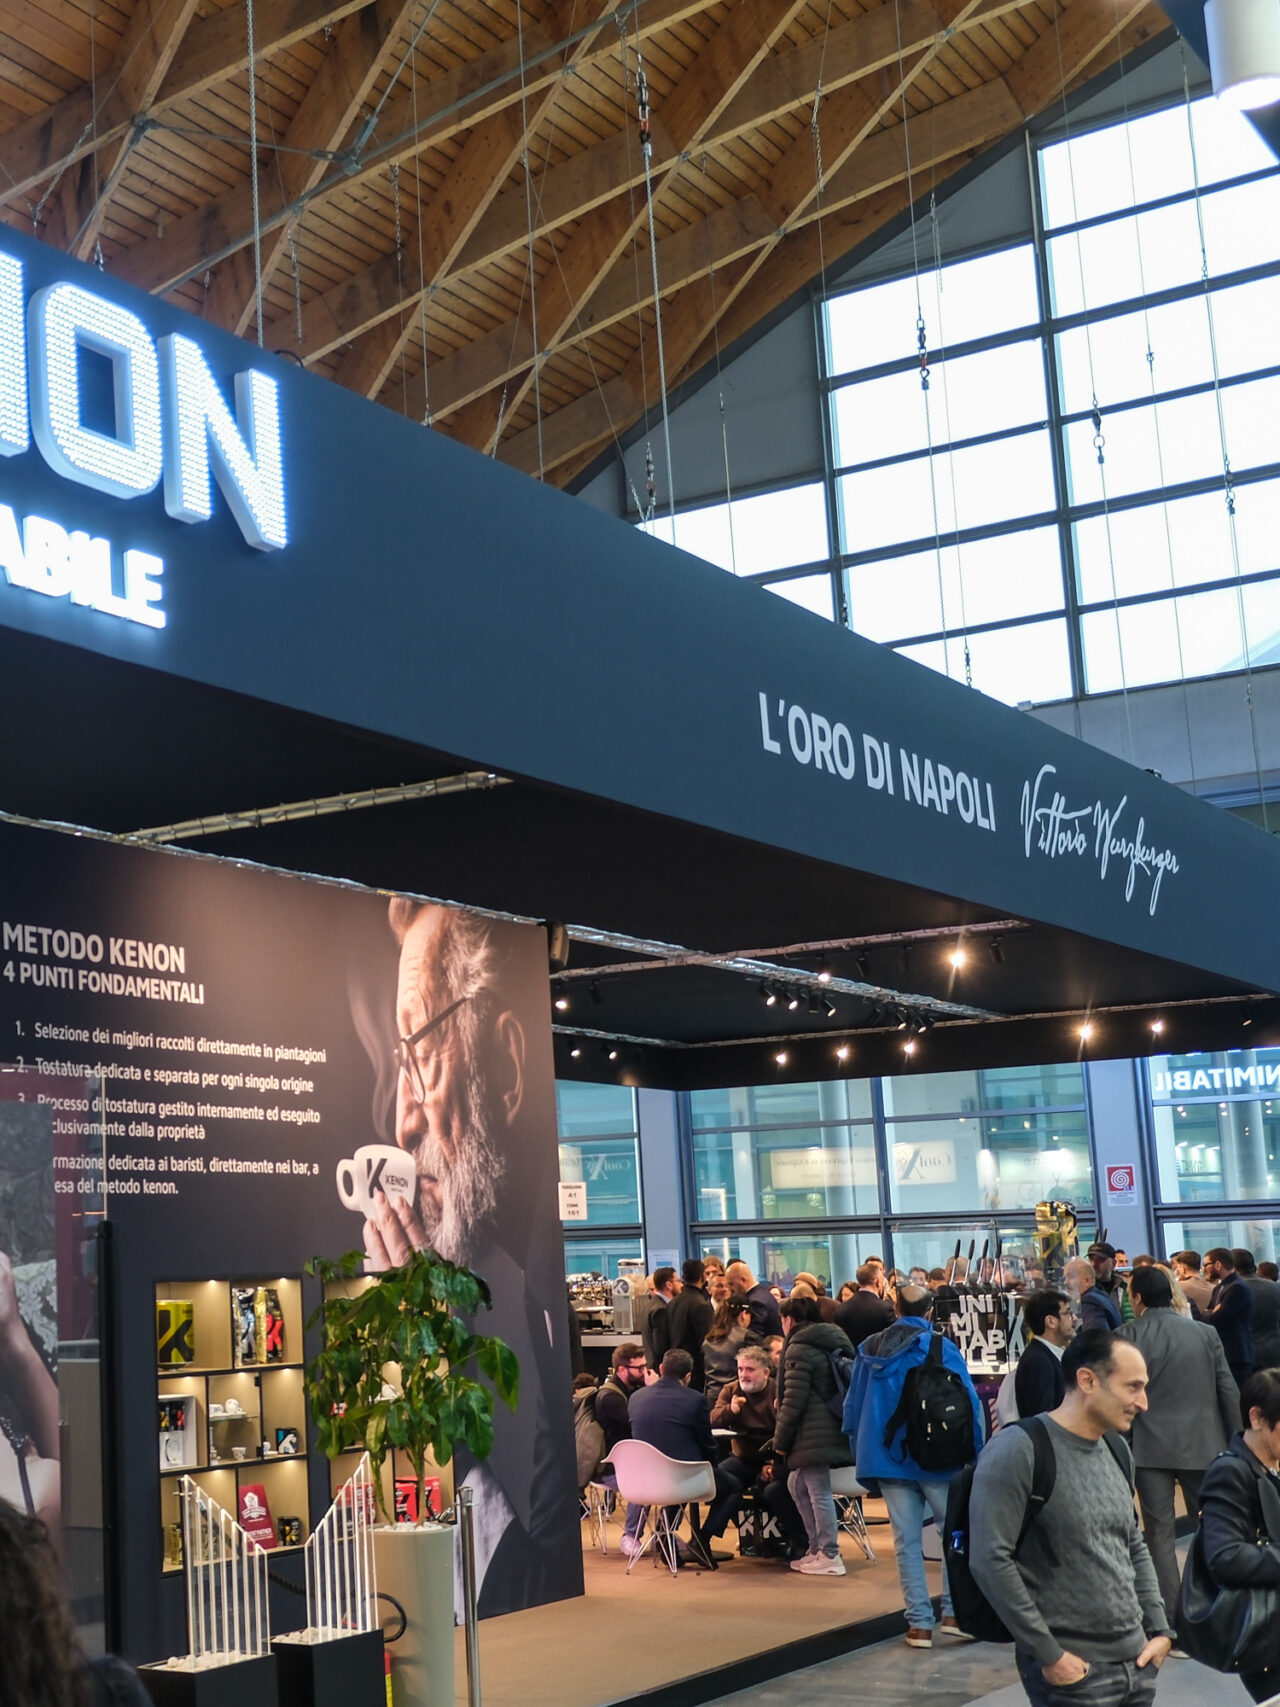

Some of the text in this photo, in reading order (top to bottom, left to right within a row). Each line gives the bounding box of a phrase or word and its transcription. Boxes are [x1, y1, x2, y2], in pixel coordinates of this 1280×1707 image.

[758, 691, 997, 833] L'ORO DI NAPOLI
[2, 921, 187, 975] METODO KENON
[3, 960, 206, 1005] 4 PUNTI FONDAMENTALI
[15, 1020, 328, 1066] 1. Selezione dei migliori raccolti direttamente in piantagioni
[15, 1055, 314, 1095] 2. Tostatura dedicata e separata per ogni singola origine
[91, 1096, 103, 1112] di
[104, 1099, 157, 1115] tostatura
[158, 1101, 196, 1119] gestito
[196, 1102, 265, 1121] internamente
[265, 1106, 279, 1122] ed
[280, 1108, 321, 1126] eseguito
[128, 1121, 154, 1137] dalla
[156, 1124, 206, 1142] proprietà
[108, 1154, 156, 1171] dedicata
[157, 1156, 169, 1171] ai
[170, 1156, 207, 1174] baristi,
[209, 1157, 274, 1174] direttamente
[275, 1159, 291, 1174] nei
[292, 1159, 311, 1176] bar,
[312, 1163, 320, 1175] a
[77, 1177, 94, 1194] del
[96, 1178, 141, 1195] metodo
[142, 1178, 179, 1195] kenon.
[959, 1293, 994, 1314] INI
[953, 1329, 1006, 1350] TAB
